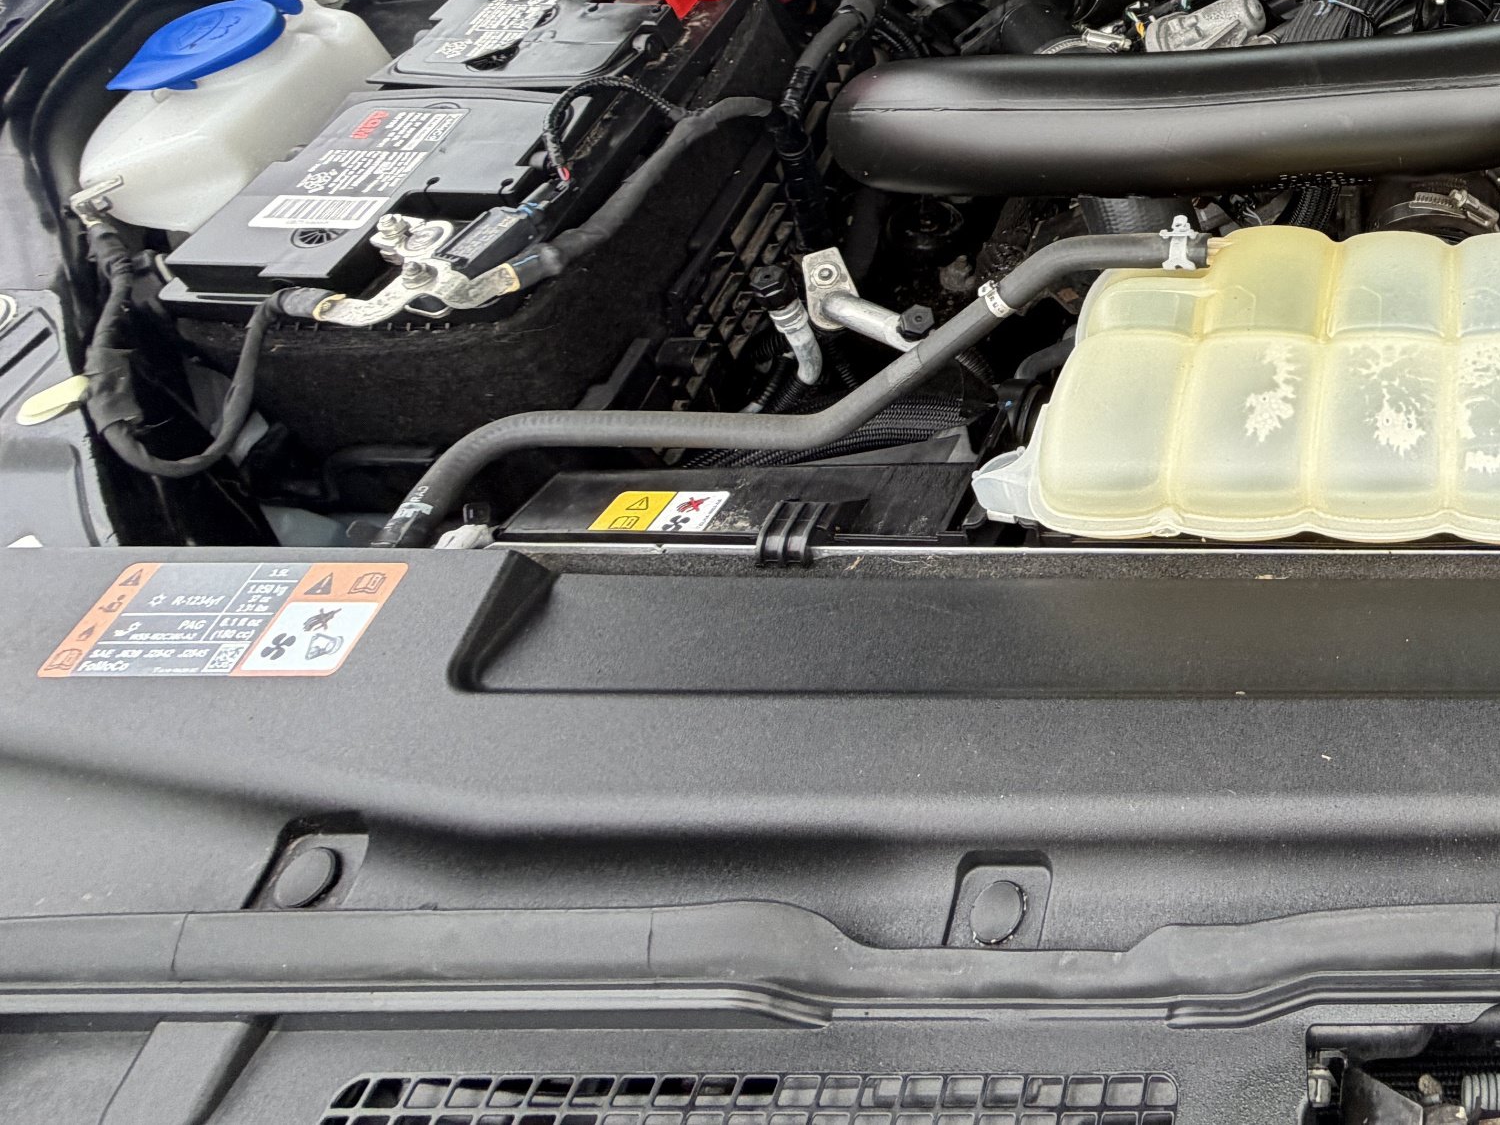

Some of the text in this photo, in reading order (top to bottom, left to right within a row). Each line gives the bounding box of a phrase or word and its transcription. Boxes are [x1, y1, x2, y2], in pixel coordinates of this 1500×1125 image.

[171, 595, 225, 608] R-1234yf
[179, 619, 207, 630] PAG
[77, 660, 130, 672] FoMoCo
